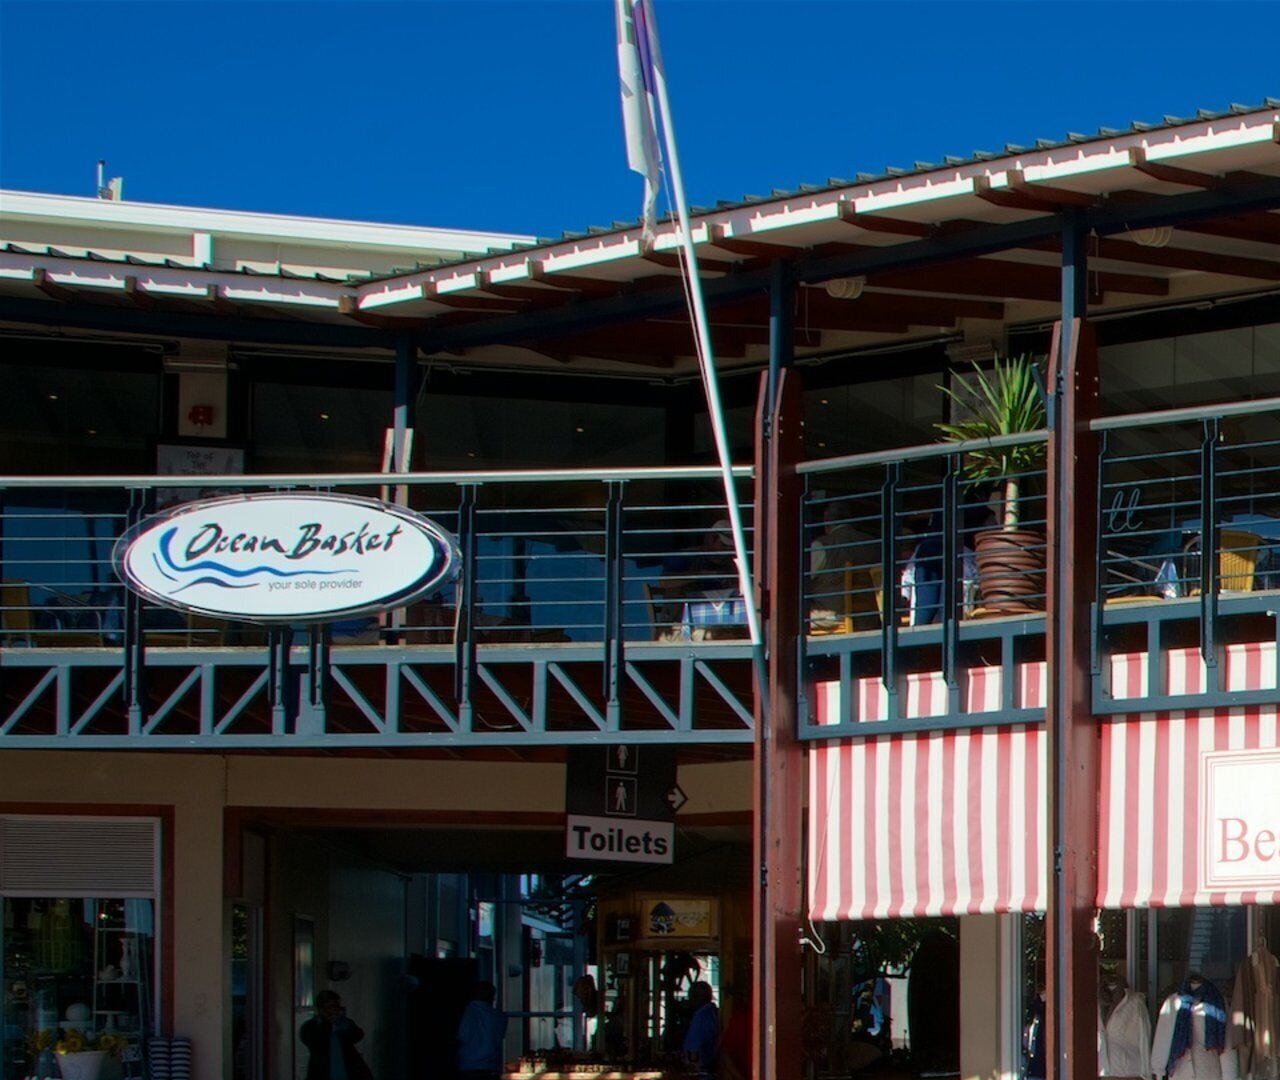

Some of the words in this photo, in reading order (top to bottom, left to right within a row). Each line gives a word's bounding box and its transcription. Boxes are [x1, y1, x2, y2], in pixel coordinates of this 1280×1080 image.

[186, 523, 290, 561] Ocean
[284, 521, 403, 559] Basket
[268, 580, 292, 592] your
[294, 578, 317, 589] sole
[319, 578, 363, 591] provider
[572, 826, 668, 855] Toilets
